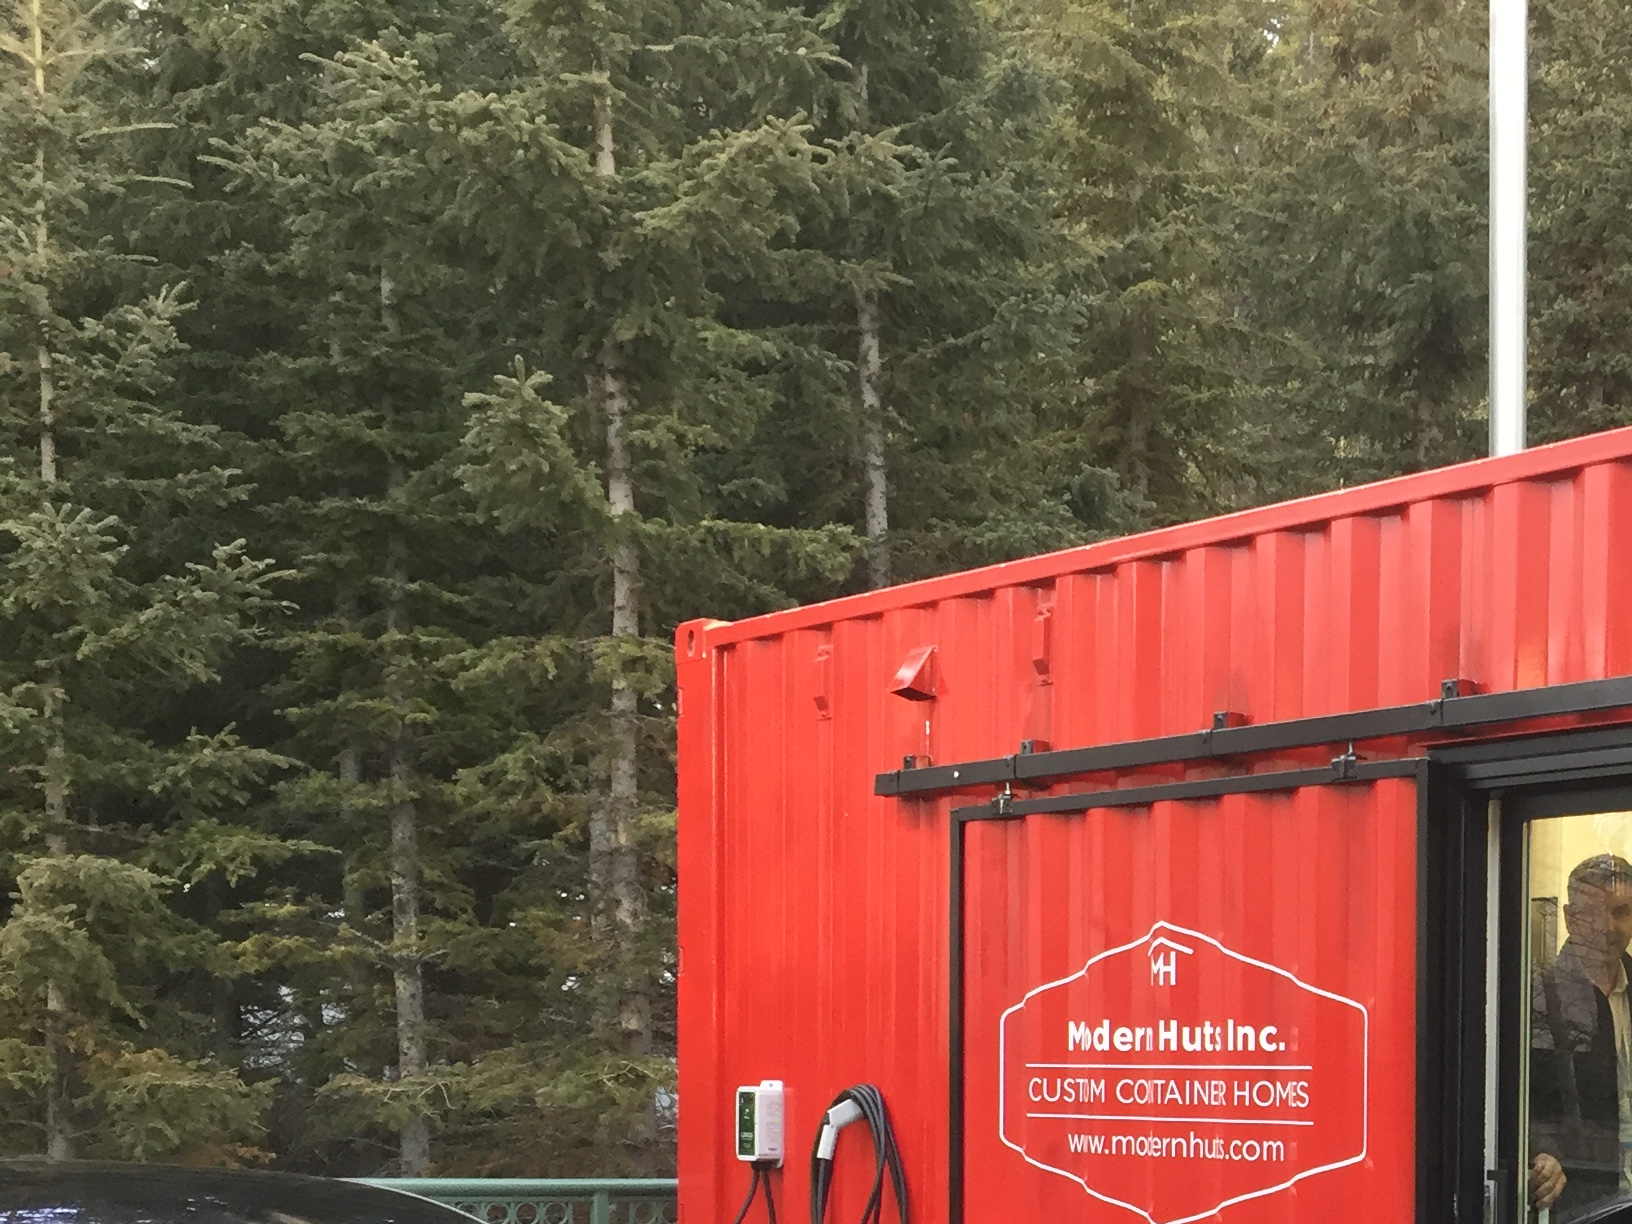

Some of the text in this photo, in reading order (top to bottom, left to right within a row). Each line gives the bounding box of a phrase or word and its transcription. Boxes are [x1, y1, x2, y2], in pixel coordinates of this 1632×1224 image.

[1068, 1019, 1285, 1052] Modern Huts Inc.
[1029, 1077, 1309, 1108] CUSTOM CONTAINER HOMES
